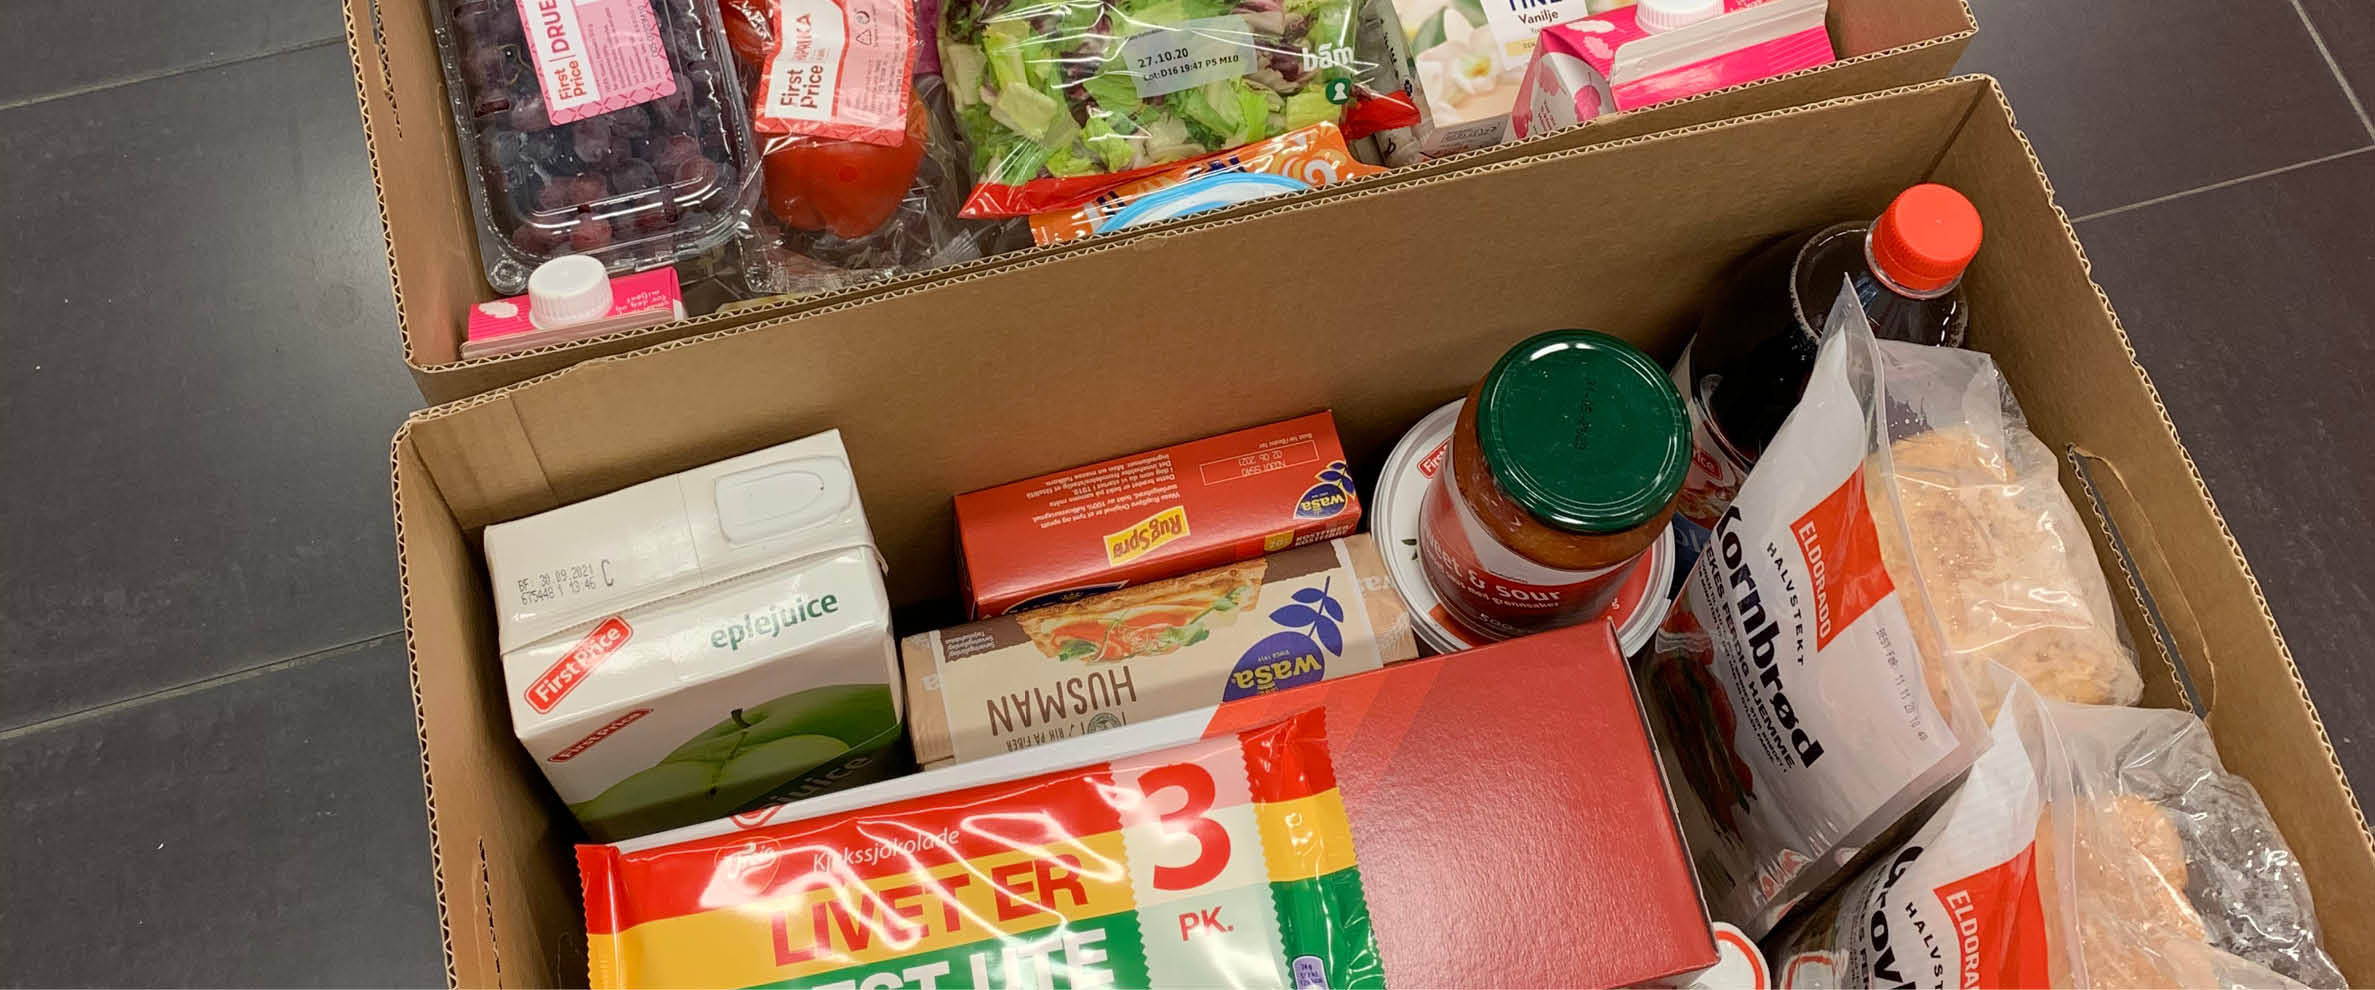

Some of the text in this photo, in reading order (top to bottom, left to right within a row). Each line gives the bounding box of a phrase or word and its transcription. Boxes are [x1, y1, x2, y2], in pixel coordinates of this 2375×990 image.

[1518, 9, 1559, 25] Vanilje
[1137, 47, 1189, 70] 27.10.20
[1179, 60, 1204, 77] 19:47
[559, 67, 574, 100] First
[573, 59, 588, 98] Price
[780, 67, 802, 109] First
[800, 63, 824, 109] Price
[1301, 493, 1345, 513] wasa
[601, 559, 614, 587] C
[1467, 569, 1486, 589] &
[1496, 585, 1560, 602] sour
[1799, 519, 1832, 640] ELDORADO
[710, 594, 839, 650] eplejuice
[1765, 541, 1805, 666] HALVSTEKT
[1233, 653, 1322, 689] wasa
[1721, 600, 1751, 678] FERDIG
[1747, 680, 1796, 770] HJEMME
[987, 666, 1137, 736] HUSMAN
[1005, 736, 1031, 752] FIBER
[1137, 762, 1233, 891] 3
[770, 852, 1090, 967] LIVET ER
[1177, 904, 1236, 942] PK.
